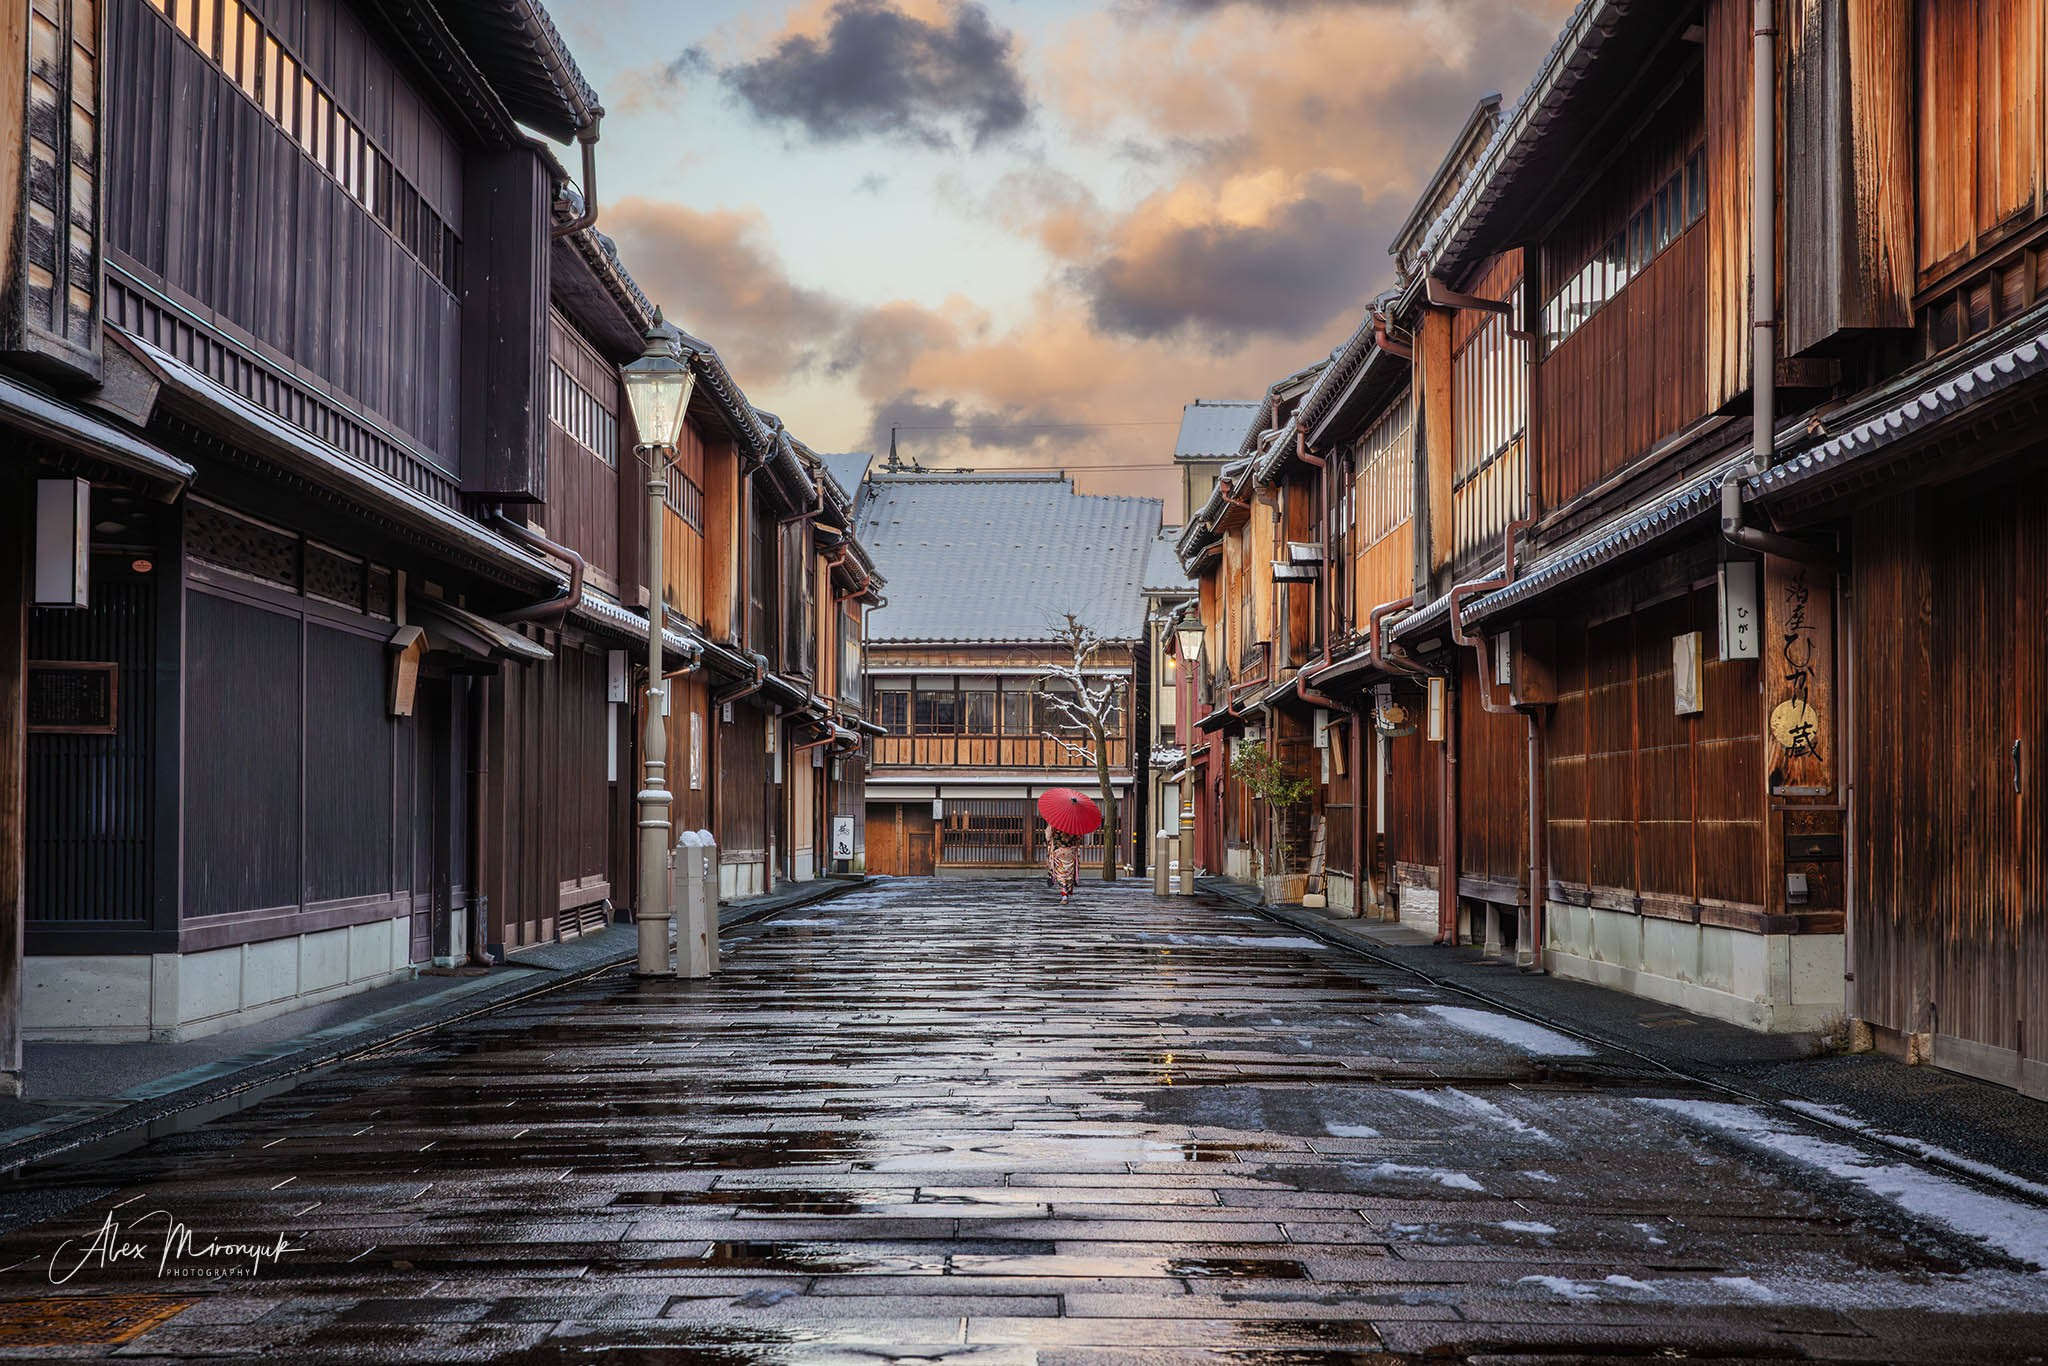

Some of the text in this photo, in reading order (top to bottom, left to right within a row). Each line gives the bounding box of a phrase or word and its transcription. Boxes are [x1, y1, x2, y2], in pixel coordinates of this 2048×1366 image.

[1736, 607, 1749, 652] ひがし
[1783, 567, 1824, 762] 箔座ひかり蔵
